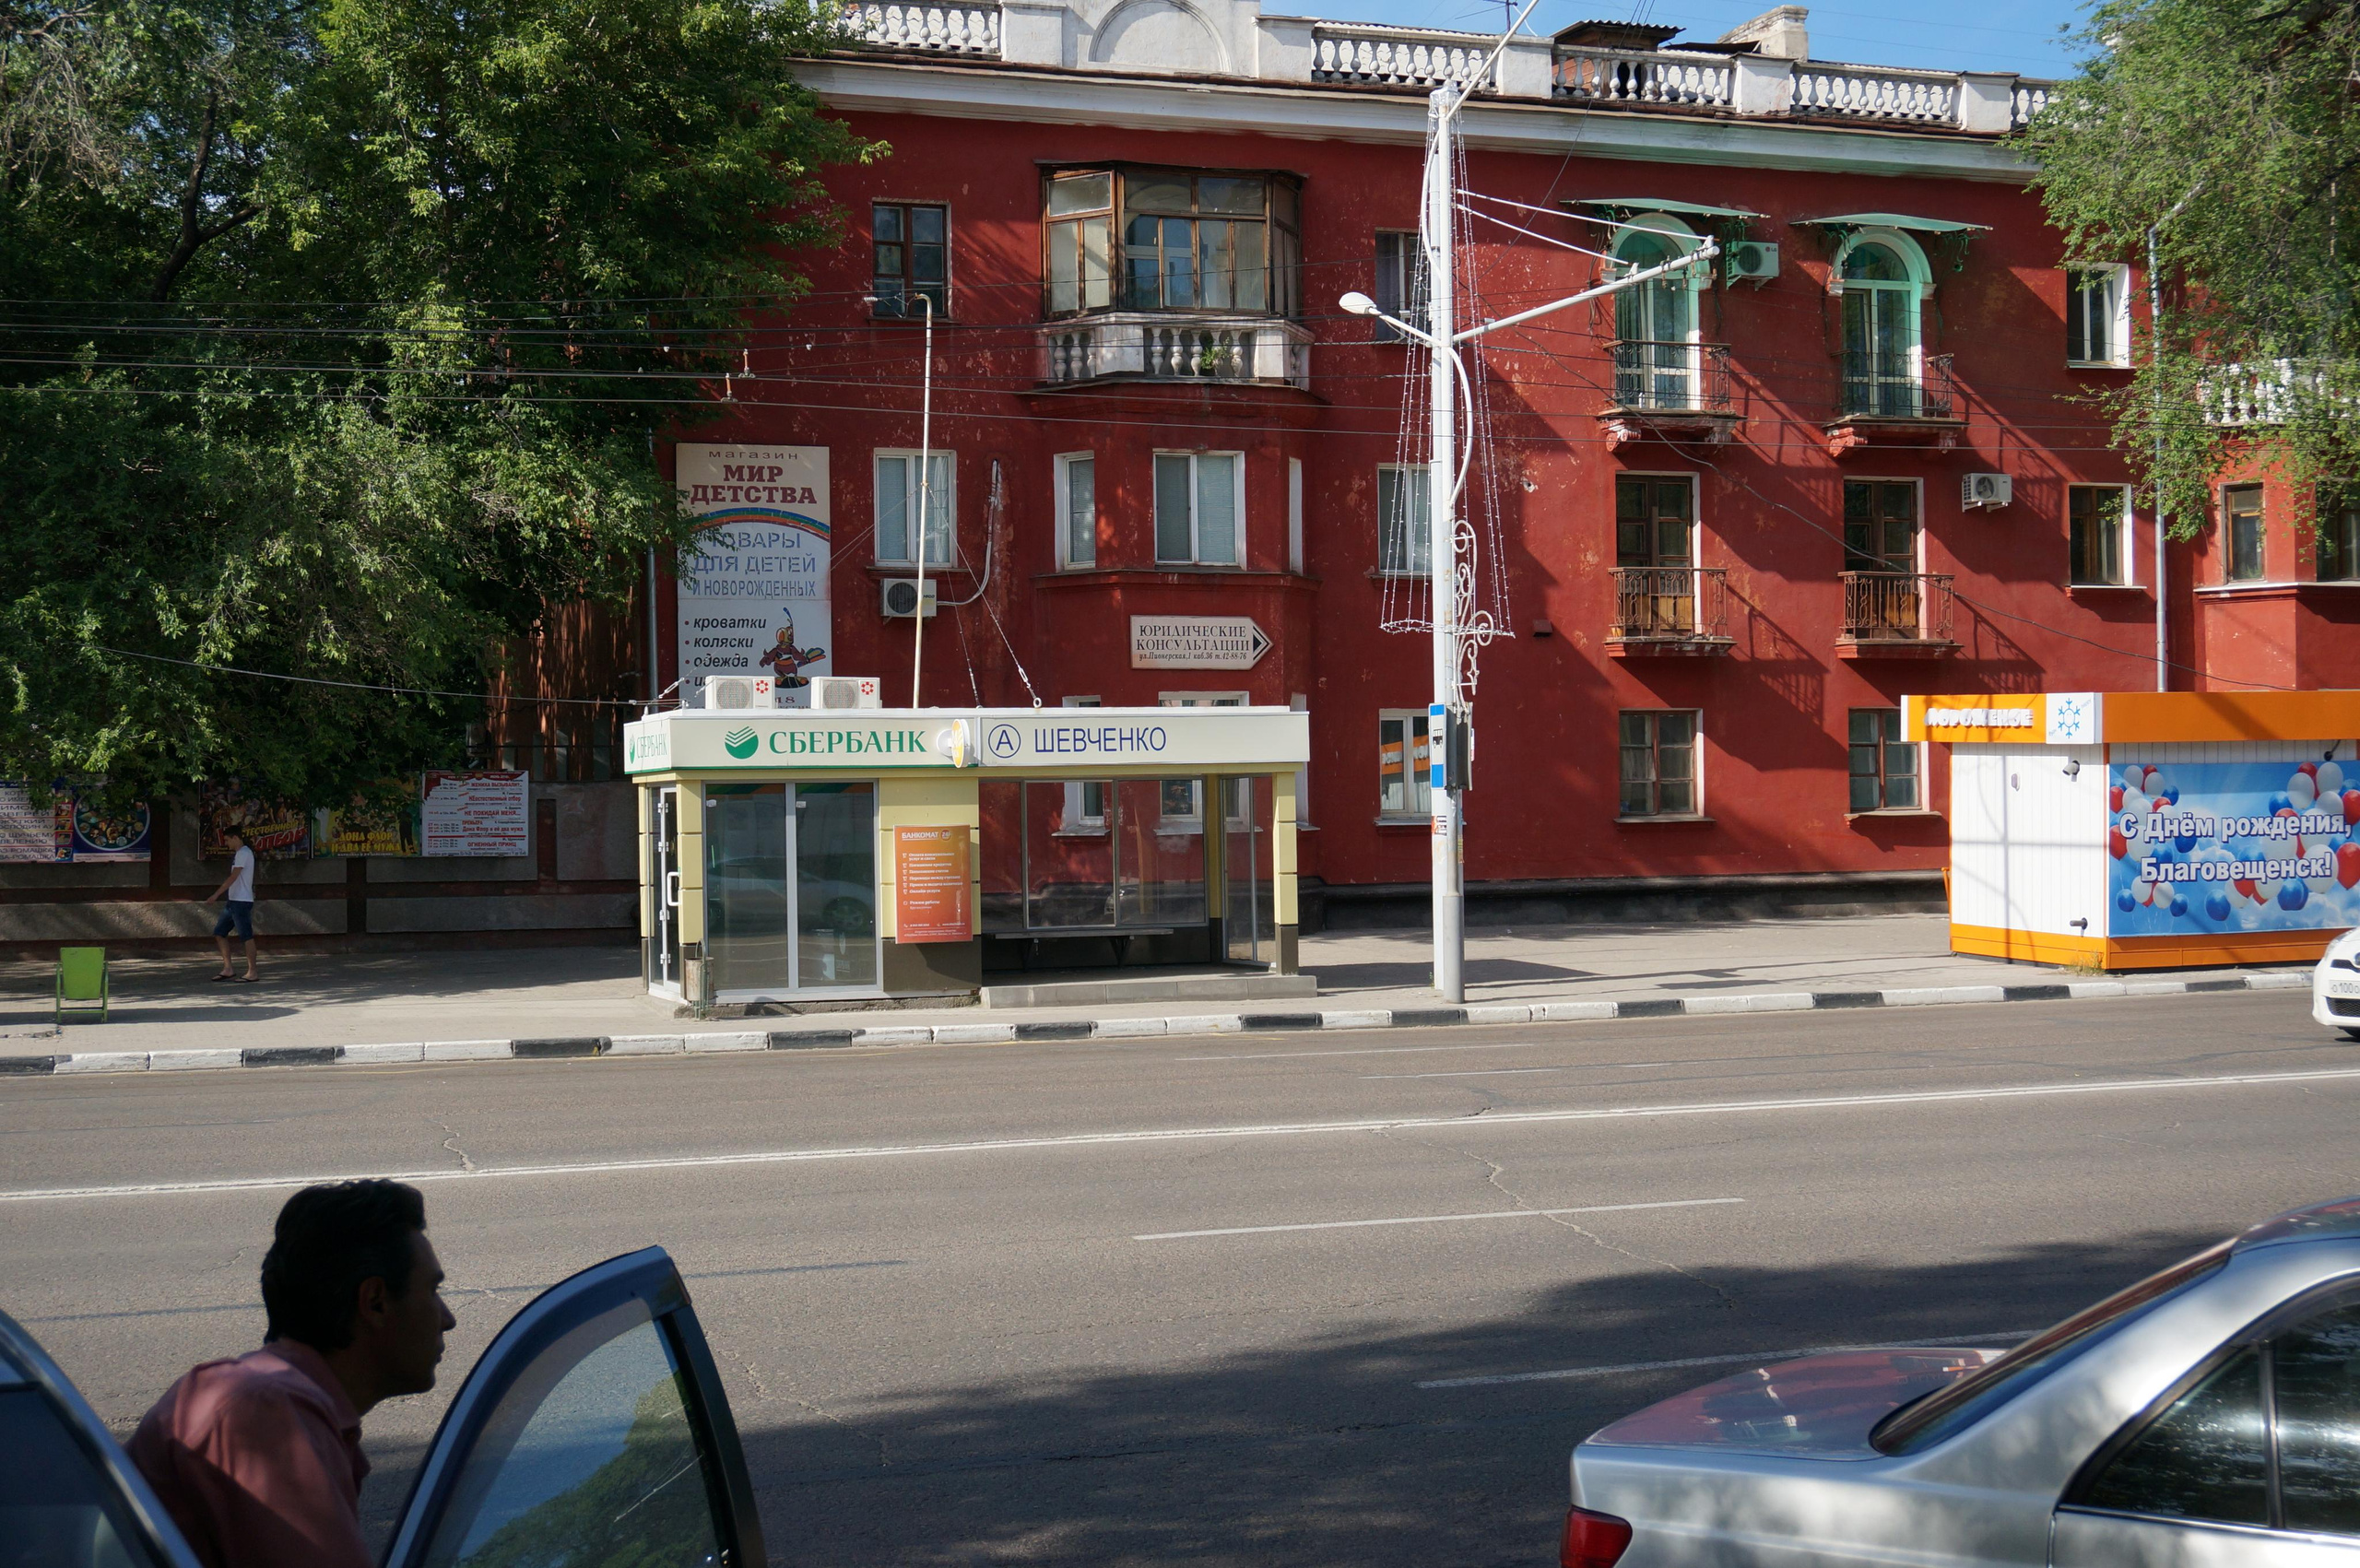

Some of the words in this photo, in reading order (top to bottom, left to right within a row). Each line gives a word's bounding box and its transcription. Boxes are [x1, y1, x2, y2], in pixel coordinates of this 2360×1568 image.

[709, 451, 797, 460] магазин
[724, 465, 784, 482] МИР
[690, 485, 817, 505] ДЕТСТВА
[693, 556, 738, 574] ДЛЯ
[745, 553, 816, 574] ДЕТЕЙ
[704, 580, 816, 598] НОВОРОЖДЕННЫХ
[693, 618, 766, 631] кроватки
[1139, 625, 1246, 638] ЮРИДИЧЕСКИЕ
[693, 637, 754, 648] коляски
[1136, 639, 1249, 652] КОНСУЛЬТАЦИИ
[693, 654, 749, 667] одежда
[637, 734, 667, 759] СБЕРБАНК
[769, 731, 927, 754] СБЕРБАНК
[1034, 726, 1166, 752] ШЕВЧЕНКО
[2119, 812, 2138, 839] С
[2143, 812, 2214, 843] Днём
[2221, 814, 2353, 843] рождения,
[2141, 852, 2332, 883] Благовещенск!
